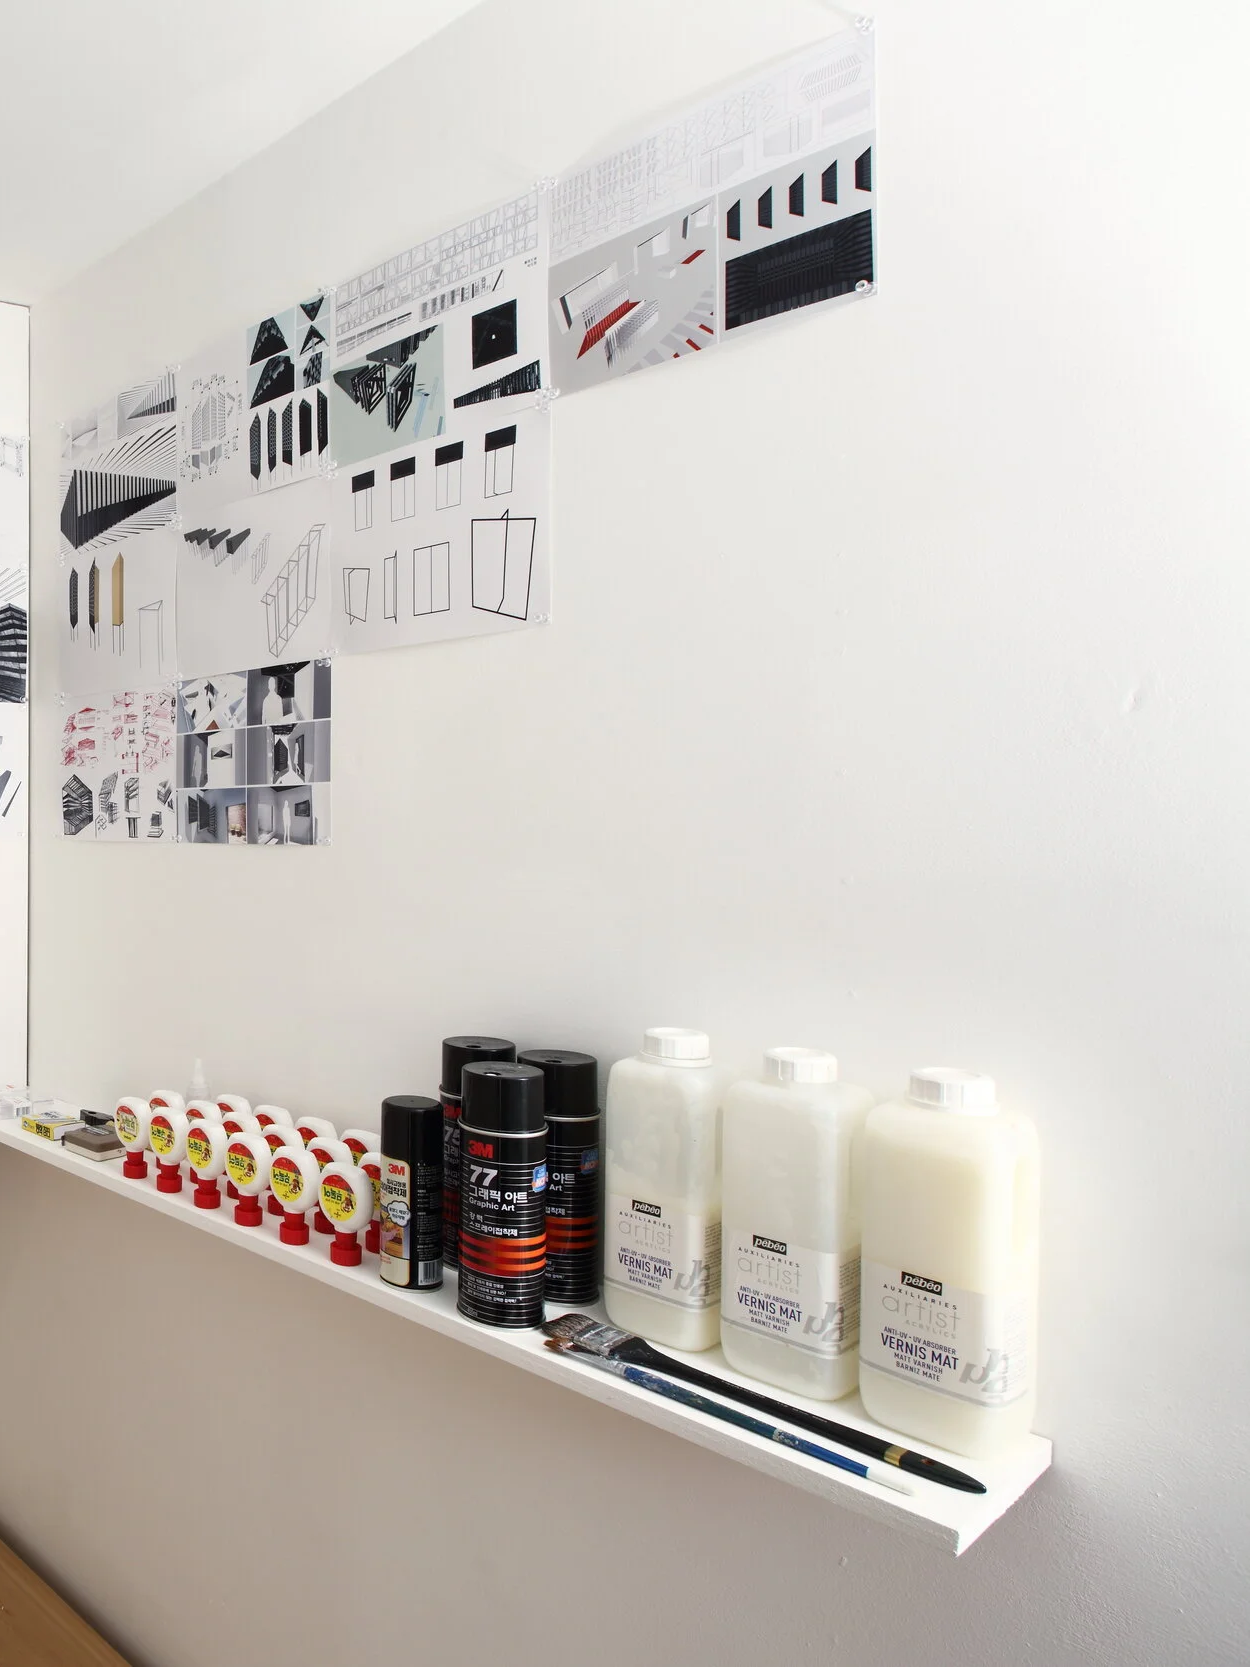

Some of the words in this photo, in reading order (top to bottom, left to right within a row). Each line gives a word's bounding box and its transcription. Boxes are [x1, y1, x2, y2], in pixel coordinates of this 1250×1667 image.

[444, 1143, 459, 1159] 그래
[468, 1139, 494, 1159] 3M
[388, 1163, 406, 1176] 3M
[470, 1164, 498, 1187] 77
[552, 1172, 575, 1184] 아트
[469, 1184, 501, 1203] 그래픽
[504, 1191, 528, 1204] 아트
[549, 1184, 562, 1192] Art
[469, 1196, 499, 1211] Graphic
[501, 1203, 515, 1212] Art
[469, 1221, 518, 1237] 스프레이접착제
[619, 1211, 672, 1229] AUXILIARIES
[618, 1220, 674, 1246] artist
[618, 1253, 651, 1273] VERNIS
[654, 1265, 672, 1279] MAT
[738, 1247, 800, 1268] AUXILIARIES
[628, 1269, 639, 1277] MATT
[641, 1271, 662, 1283] VARNISH
[737, 1258, 802, 1287] artist
[629, 1276, 646, 1286] BARNIZ
[648, 1282, 660, 1290] MATE
[740, 1286, 760, 1296] ANTI-UV
[772, 1295, 800, 1308] ABSORBER
[883, 1283, 957, 1310] AUXILIARIES
[737, 1292, 775, 1314] VERNIS
[780, 1306, 802, 1322] MAT
[882, 1296, 962, 1331] artist
[749, 1309, 763, 1318] MATT
[765, 1313, 789, 1326] VARNISH
[751, 1317, 771, 1328] BARNIZ
[773, 1324, 788, 1333] MATE
[906, 1320, 956, 1339] ACRYLICS
[884, 1326, 907, 1339] ANTI-UV
[913, 1336, 922, 1345] UV
[922, 1339, 956, 1355] ABSORBER
[881, 1333, 926, 1360] VERNIS
[931, 1350, 959, 1370] MAT
[894, 1352, 912, 1363] MATT
[913, 1357, 943, 1374] VARNISH
[896, 1361, 920, 1375] BARNIZ
[922, 1370, 940, 1382] MATE
